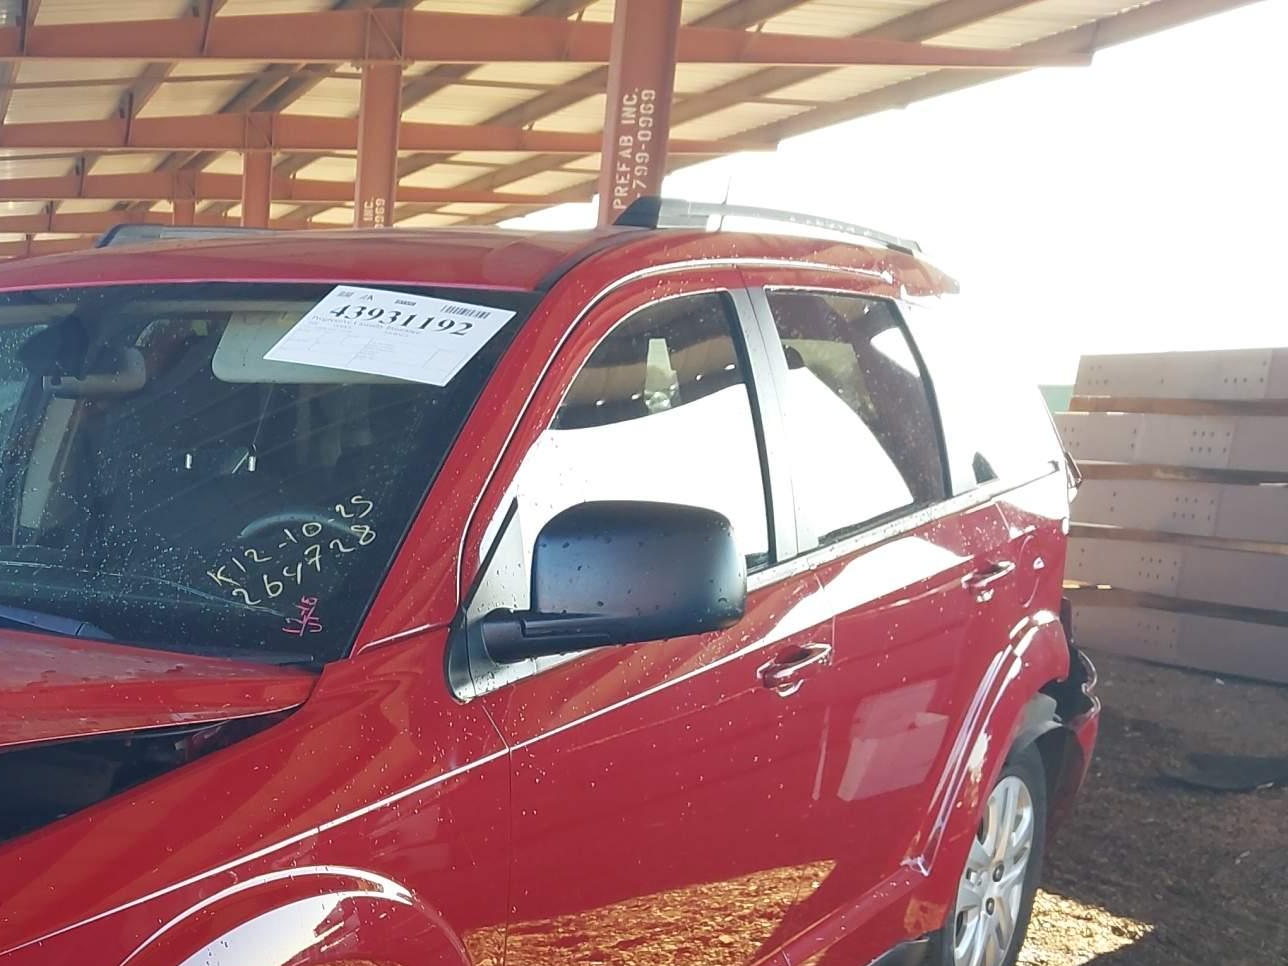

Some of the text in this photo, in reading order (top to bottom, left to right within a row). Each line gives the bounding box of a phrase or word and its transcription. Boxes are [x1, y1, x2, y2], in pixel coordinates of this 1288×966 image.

[613, 88, 639, 210] PREFAB INC.
[329, 304, 473, 336] 43931192
